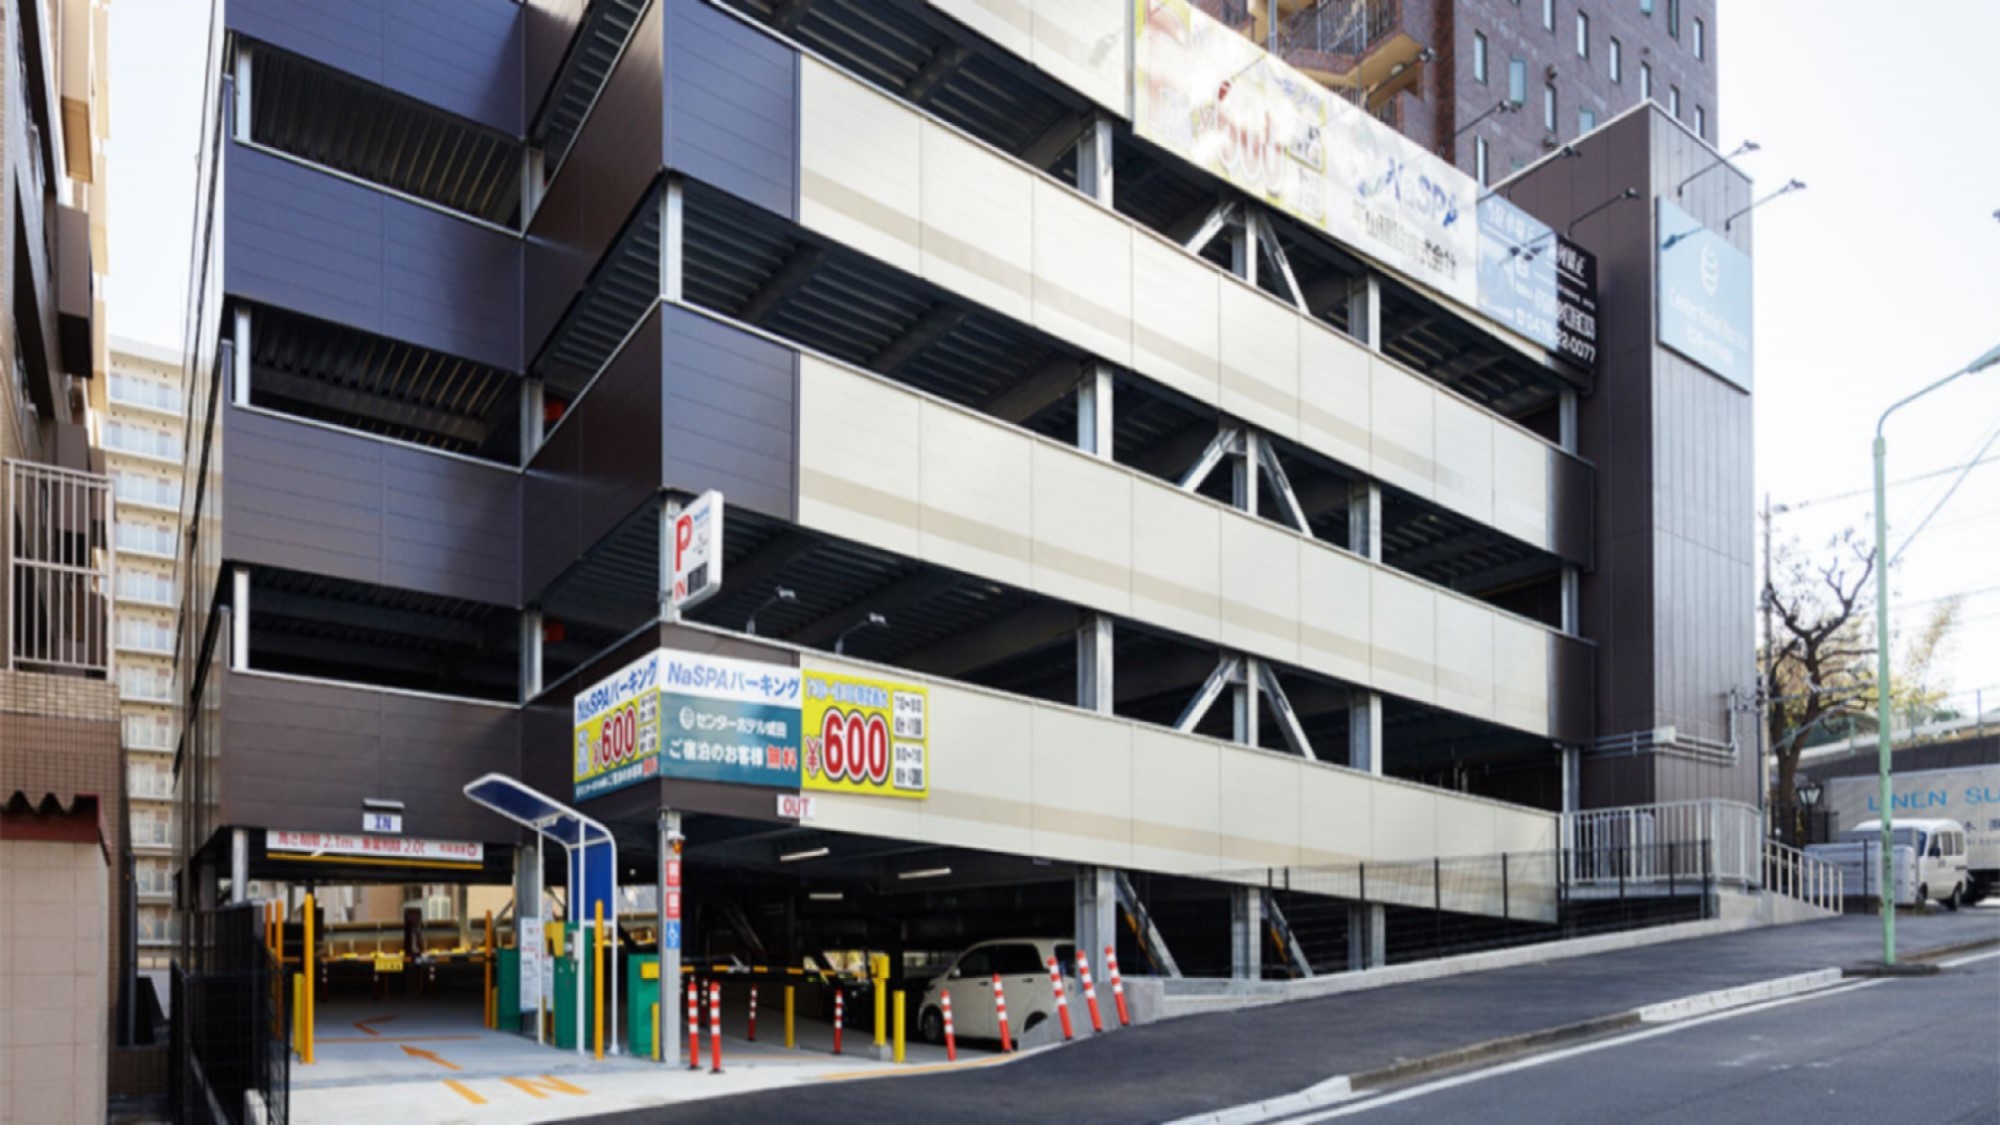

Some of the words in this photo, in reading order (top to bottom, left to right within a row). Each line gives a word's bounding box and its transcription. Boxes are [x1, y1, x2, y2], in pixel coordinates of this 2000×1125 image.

[675, 514, 693, 573] P
[667, 661, 800, 699] NaSPAパーキング
[669, 738, 763, 767] ご宿泊のお客様
[766, 743, 797, 772] 無料
[803, 708, 889, 783] ¥600
[783, 797, 810, 817] OUT
[1867, 790, 1946, 812] LNEN
[374, 814, 393, 831] IN
